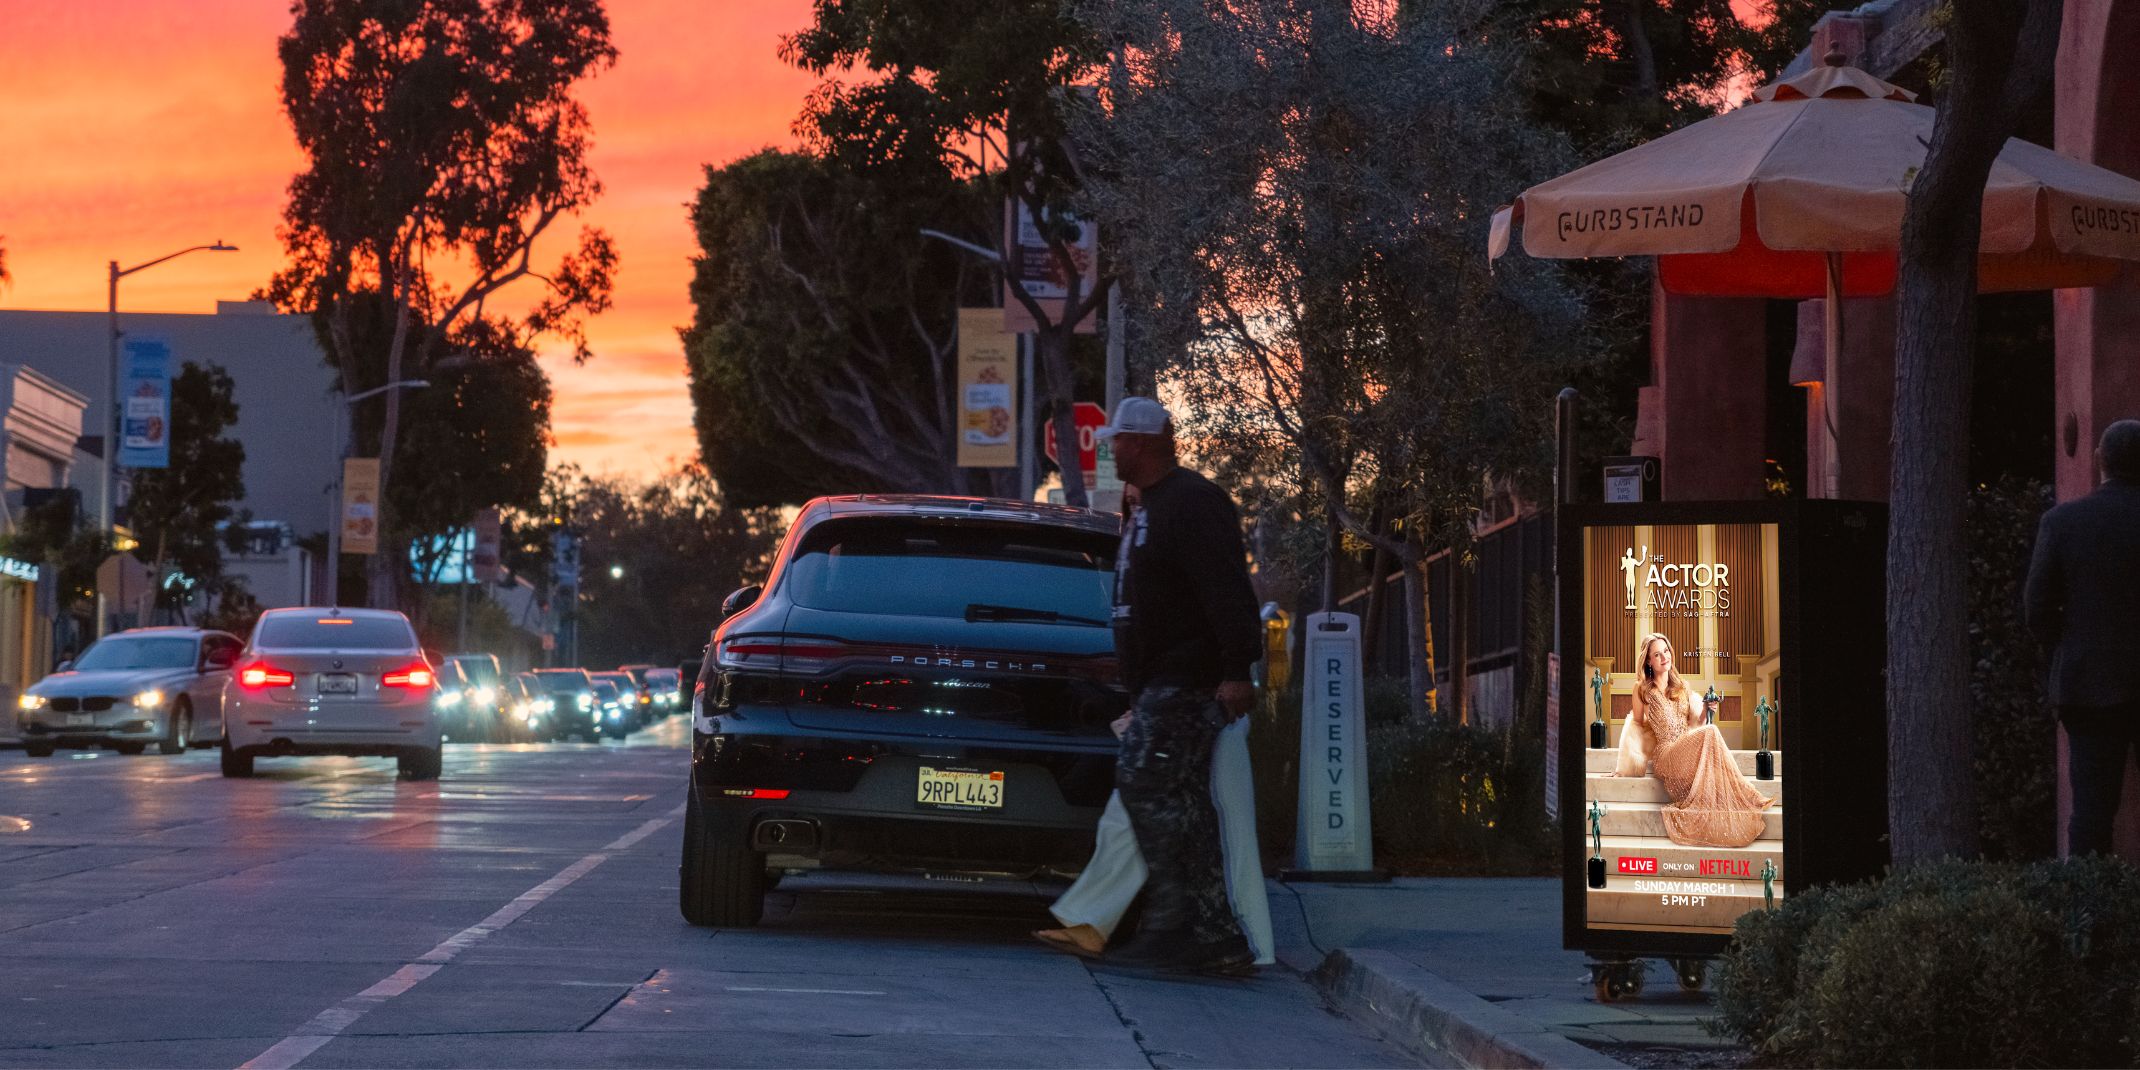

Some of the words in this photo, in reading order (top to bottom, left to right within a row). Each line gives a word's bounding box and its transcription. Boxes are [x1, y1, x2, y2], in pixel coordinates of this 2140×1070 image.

[1558, 204, 1704, 242] CURBSTAND
[1649, 555, 1664, 563] THE
[1645, 563, 1730, 587] ACTOR
[1645, 589, 1730, 610] AWARDS
[890, 655, 1046, 671] PORSCHE
[943, 678, 991, 689] Macan
[1327, 658, 1344, 829] RESERVED
[921, 780, 999, 805] 9RPL443
[1629, 860, 1653, 871] LIVE
[1663, 863, 1682, 871] ONLY
[1683, 863, 1695, 871] ON
[1700, 858, 1750, 877] NETFLIX
[1634, 880, 1681, 892] SUNDAY
[1683, 882, 1726, 894] MARCH
[1729, 883, 1735, 894] 1
[1661, 894, 1669, 906] 5
[1671, 895, 1689, 906] PM
[1691, 896, 1707, 907] PT
